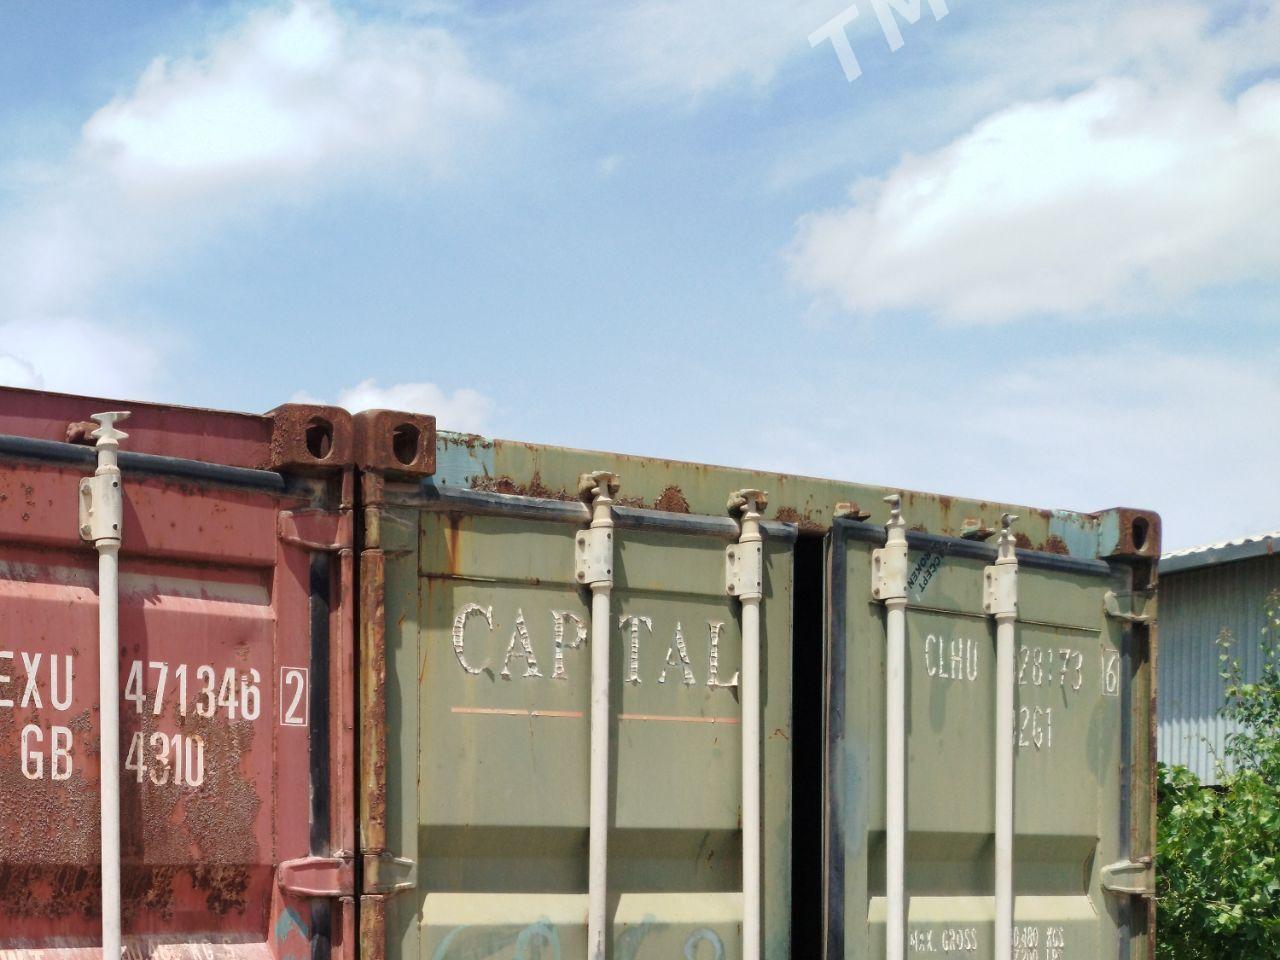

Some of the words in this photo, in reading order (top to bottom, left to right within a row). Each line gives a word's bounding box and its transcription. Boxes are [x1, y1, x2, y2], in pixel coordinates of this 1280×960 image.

[452, 602, 740, 687] CAPTAL
[925, 634, 978, 681] CLHU
[1013, 647, 1084, 690] 28173
[124, 660, 261, 721] 471346
[284, 670, 305, 724] 2
[20, 724, 74, 781] GB
[124, 730, 205, 788] 4310
